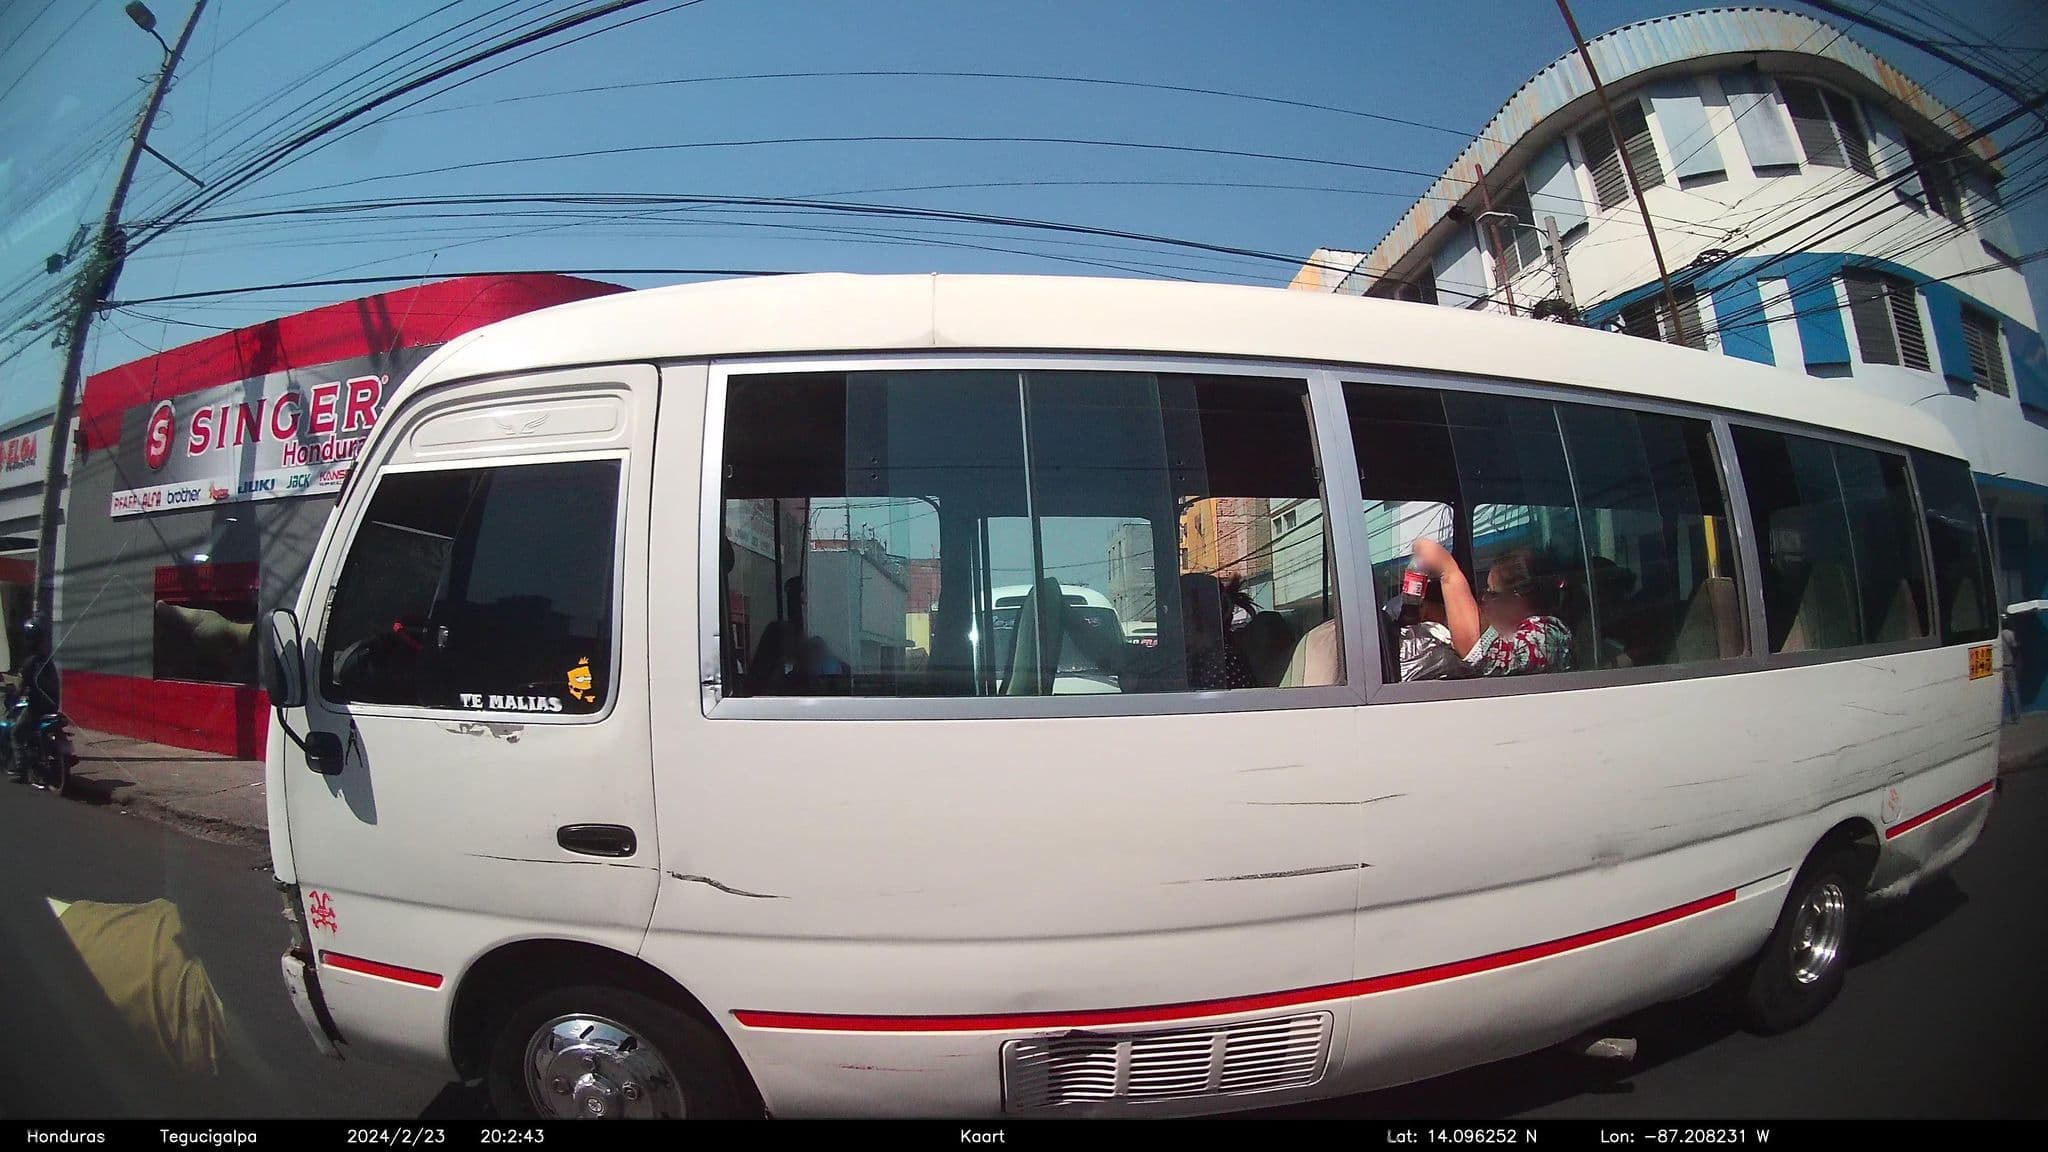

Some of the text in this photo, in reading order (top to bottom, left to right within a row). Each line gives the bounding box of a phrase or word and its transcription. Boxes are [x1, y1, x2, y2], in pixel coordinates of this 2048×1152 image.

[187, 376, 382, 458] SINGER
[238, 478, 275, 494] JUKI
[167, 488, 201, 504] brother
[460, 693, 563, 712] TE MALIAS
